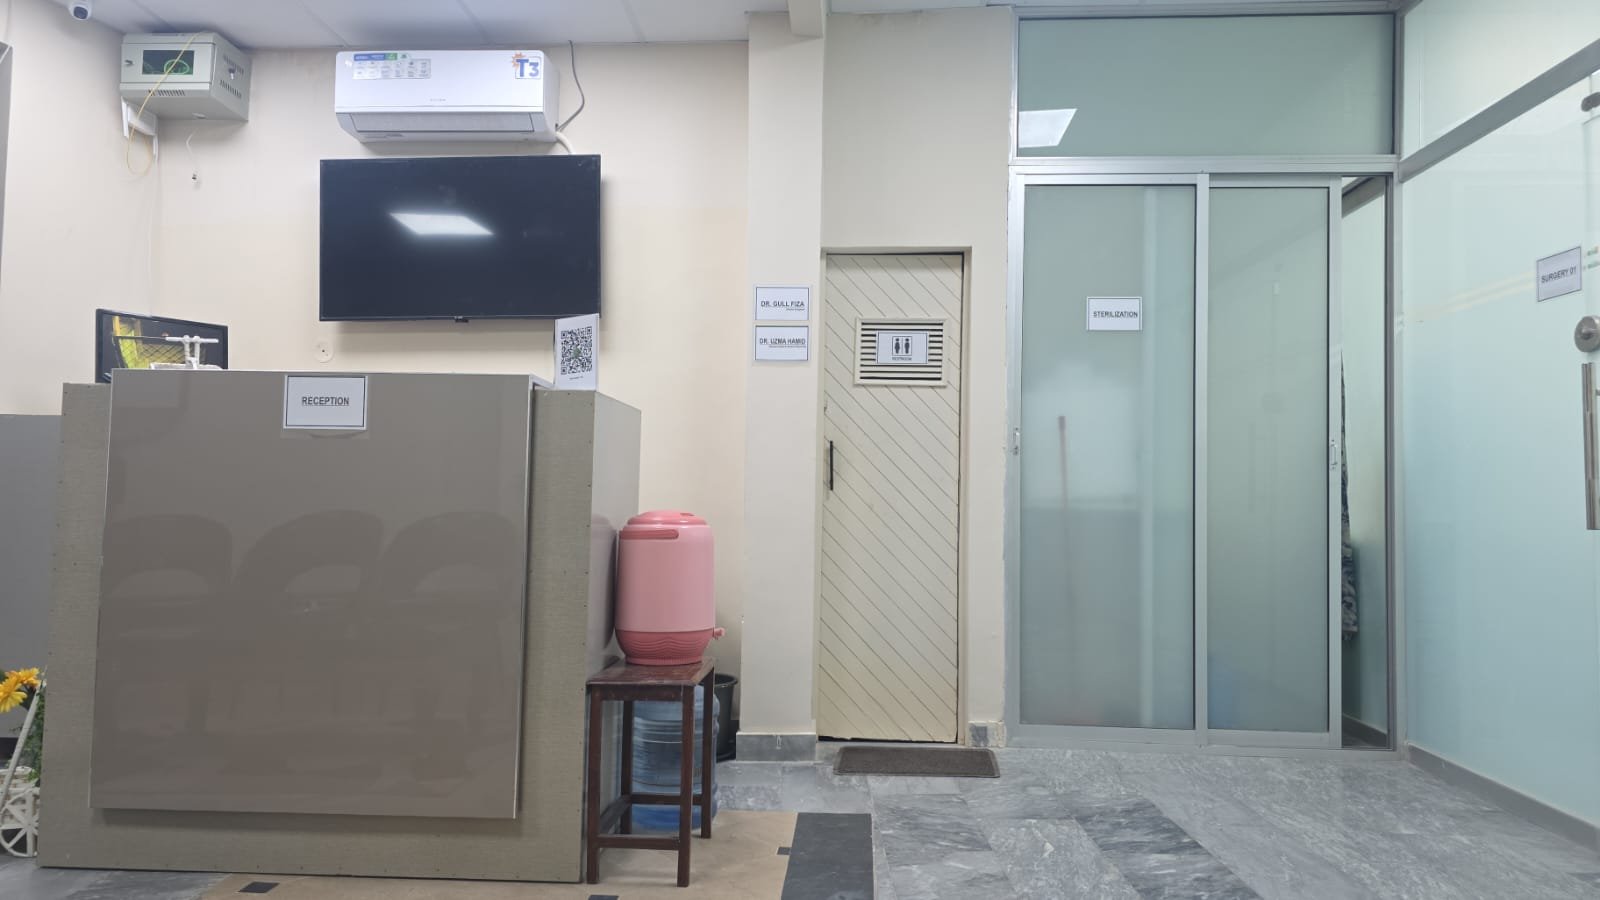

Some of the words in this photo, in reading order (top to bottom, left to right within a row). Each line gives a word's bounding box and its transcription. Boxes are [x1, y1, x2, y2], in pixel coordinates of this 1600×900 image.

[516, 58, 540, 78] T3
[1541, 269, 1569, 283] SURGERY
[1570, 266, 1577, 275] 01
[301, 396, 350, 406] RECEPTION
